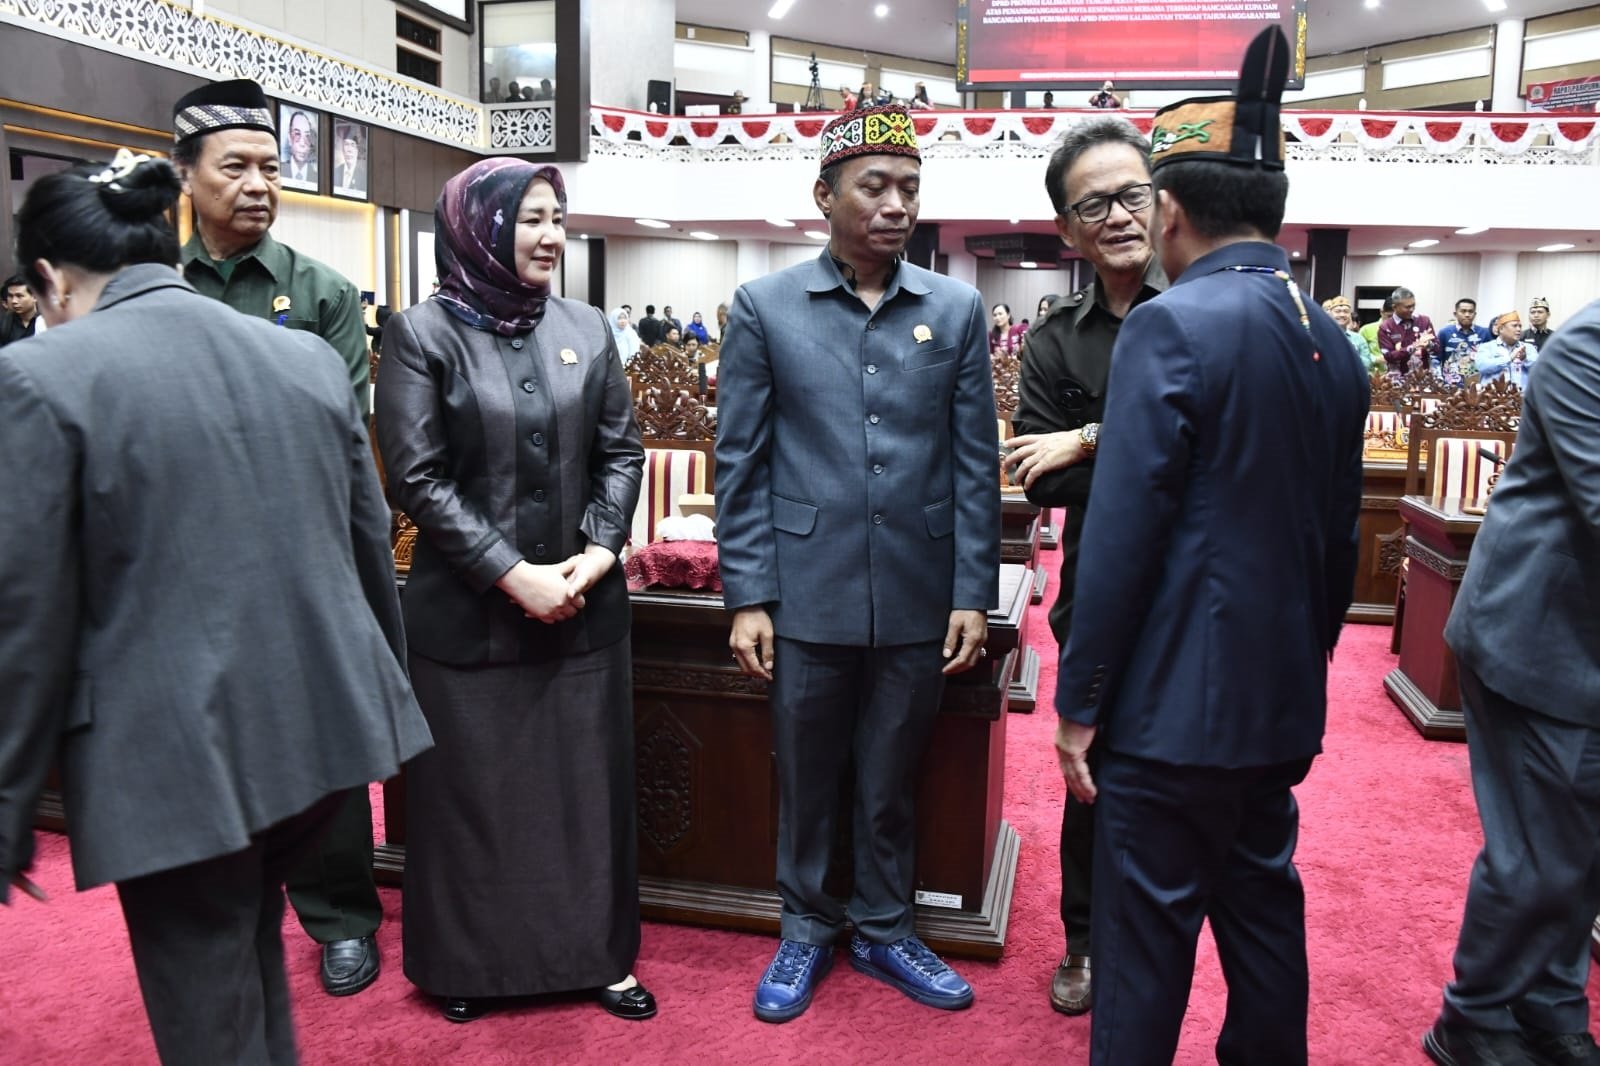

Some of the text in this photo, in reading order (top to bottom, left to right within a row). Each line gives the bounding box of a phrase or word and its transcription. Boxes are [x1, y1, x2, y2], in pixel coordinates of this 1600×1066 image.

[1201, 4, 1243, 12] RANCANGAN
[1262, 3, 1278, 11] DAN
[983, 16, 1023, 24] RANCANGAN
[1174, 13, 1202, 21] TENGAH
[1226, 12, 1264, 20] ANGGARAN
